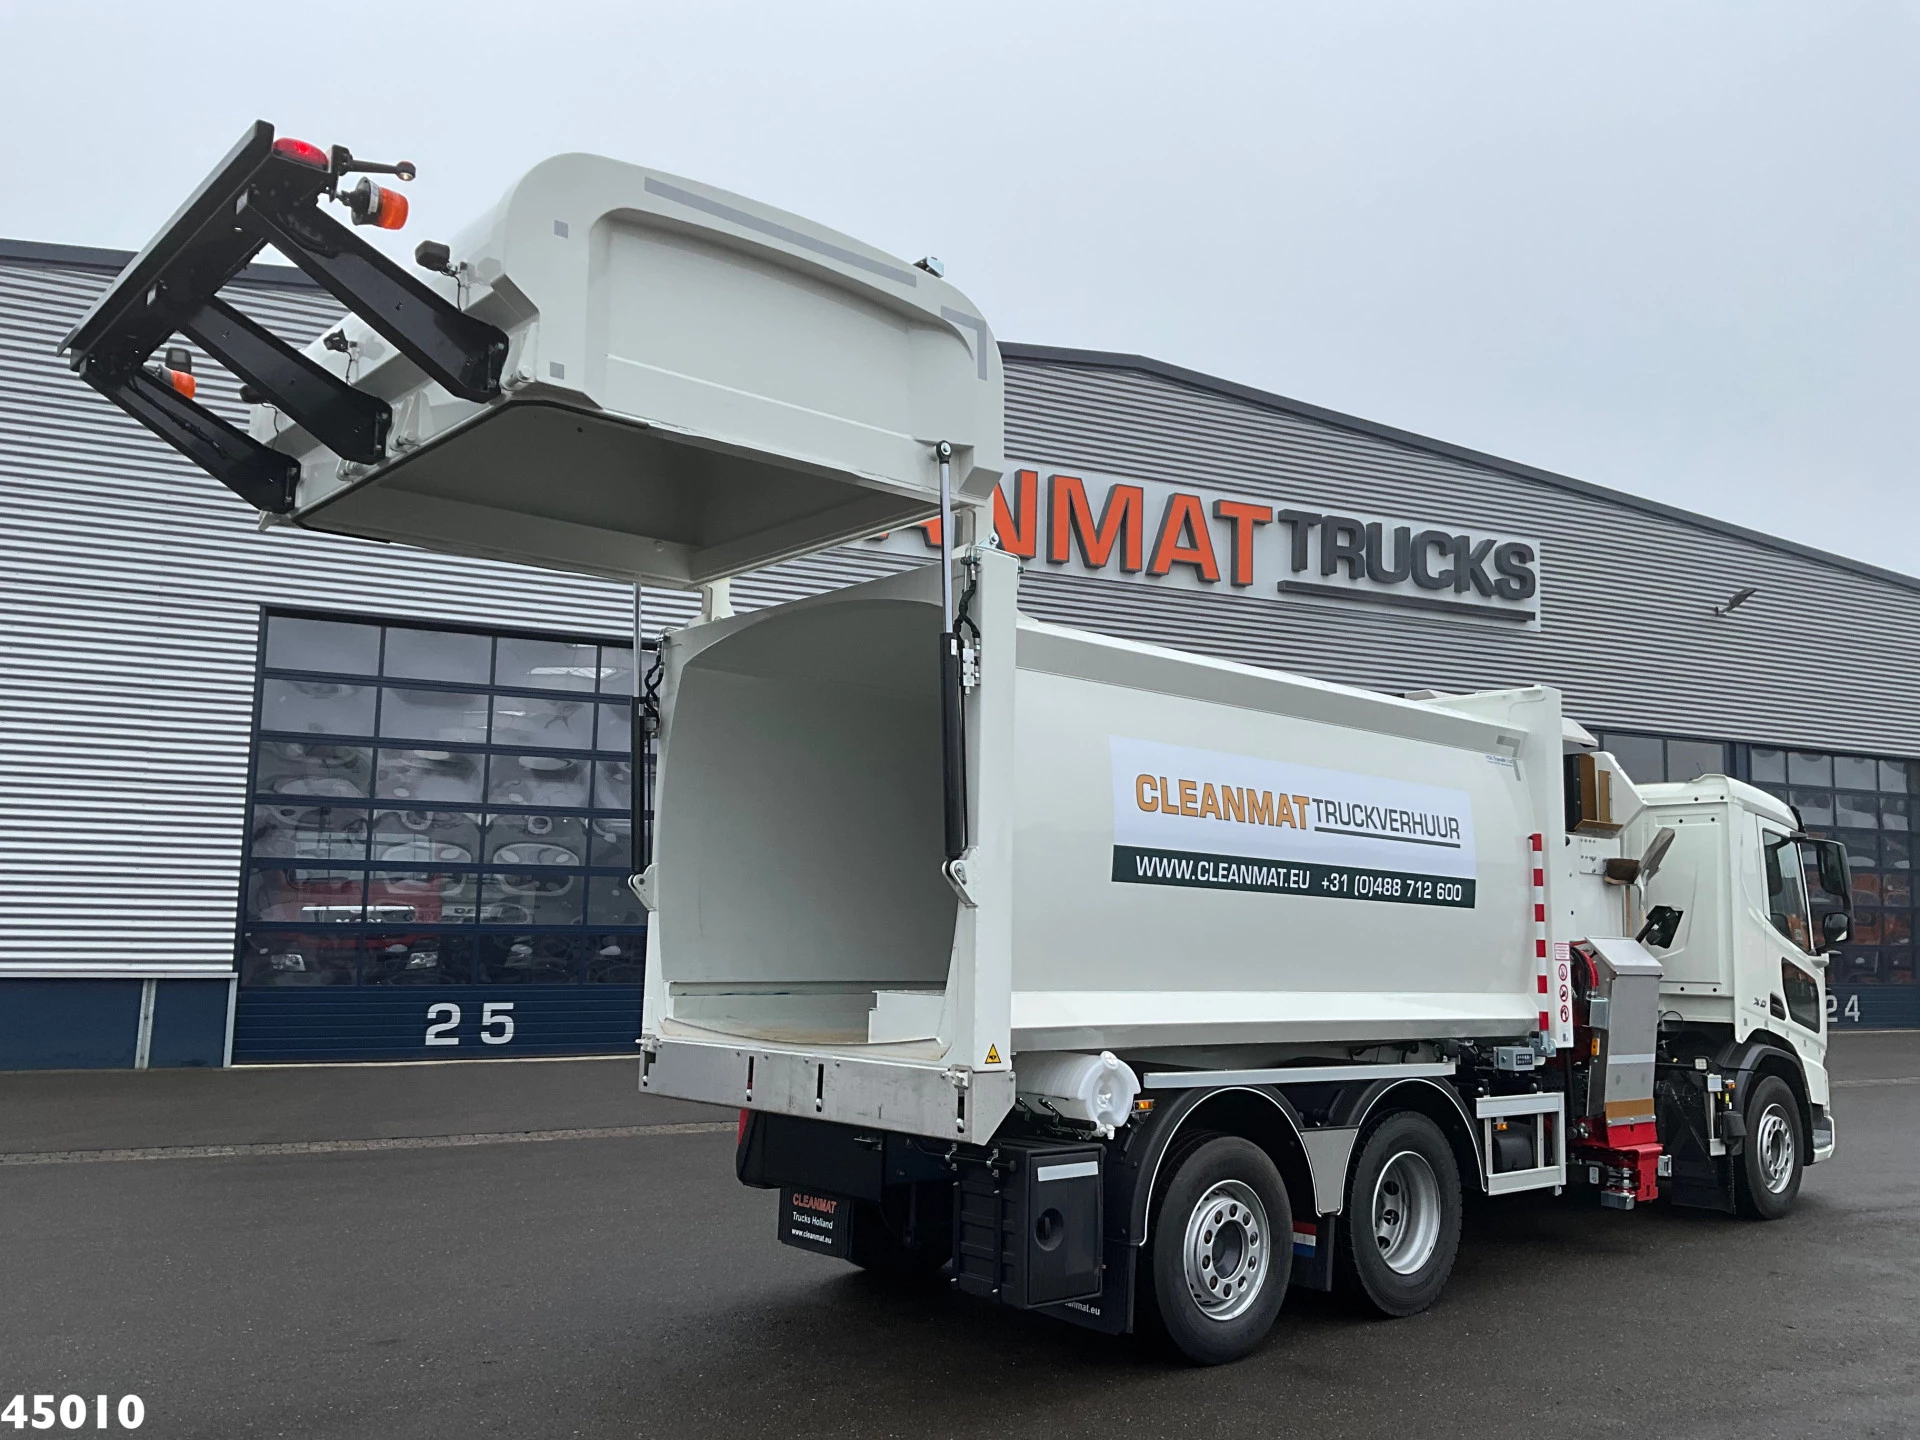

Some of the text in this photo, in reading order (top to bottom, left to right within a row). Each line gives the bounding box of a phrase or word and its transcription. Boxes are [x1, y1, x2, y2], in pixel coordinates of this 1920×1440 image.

[866, 469, 1536, 600] NMAT TRUCKS
[1135, 773, 1461, 840] CLEANMAT TRUCKVERHUUR
[1135, 855, 1462, 902] WWW.CLEANMAT.EU +31 (0)488 712 600
[792, 1193, 837, 1214] CLEANMAT
[792, 1211, 834, 1229] Trucks Holland
[791, 1228, 832, 1244] www.cleanmat.eu
